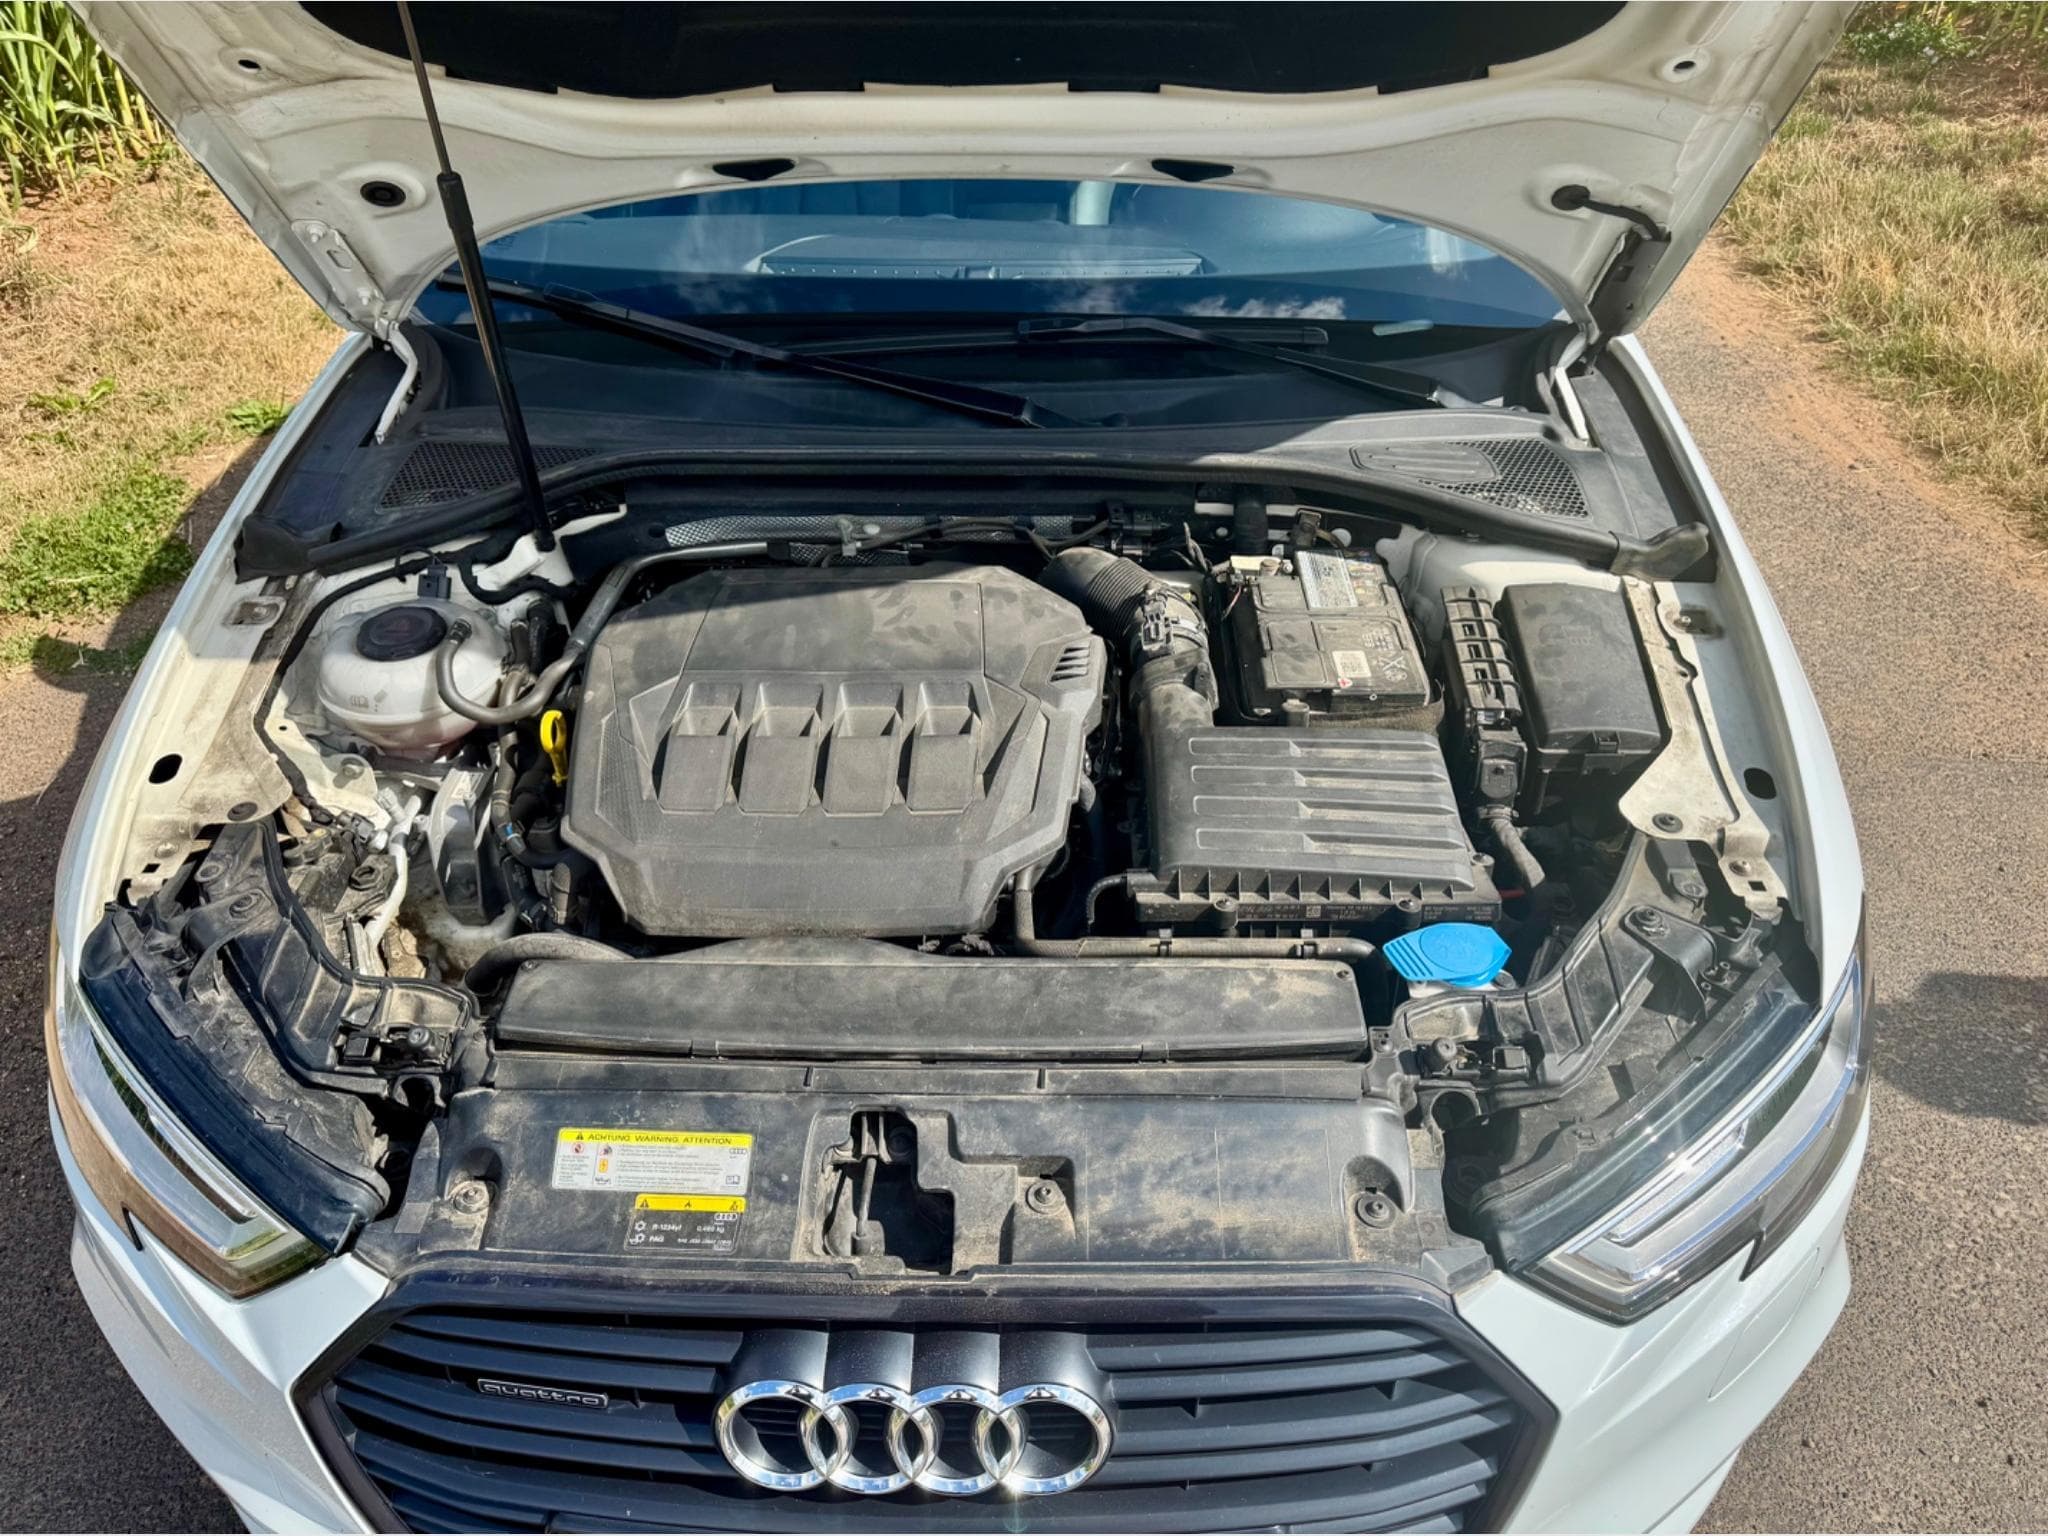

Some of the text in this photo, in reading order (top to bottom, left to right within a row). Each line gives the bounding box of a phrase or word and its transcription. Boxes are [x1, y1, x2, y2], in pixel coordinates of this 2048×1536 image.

[588, 1134, 732, 1145] ACHTUNG WARNING ATTENTION
[483, 1384, 599, 1405] quattro
